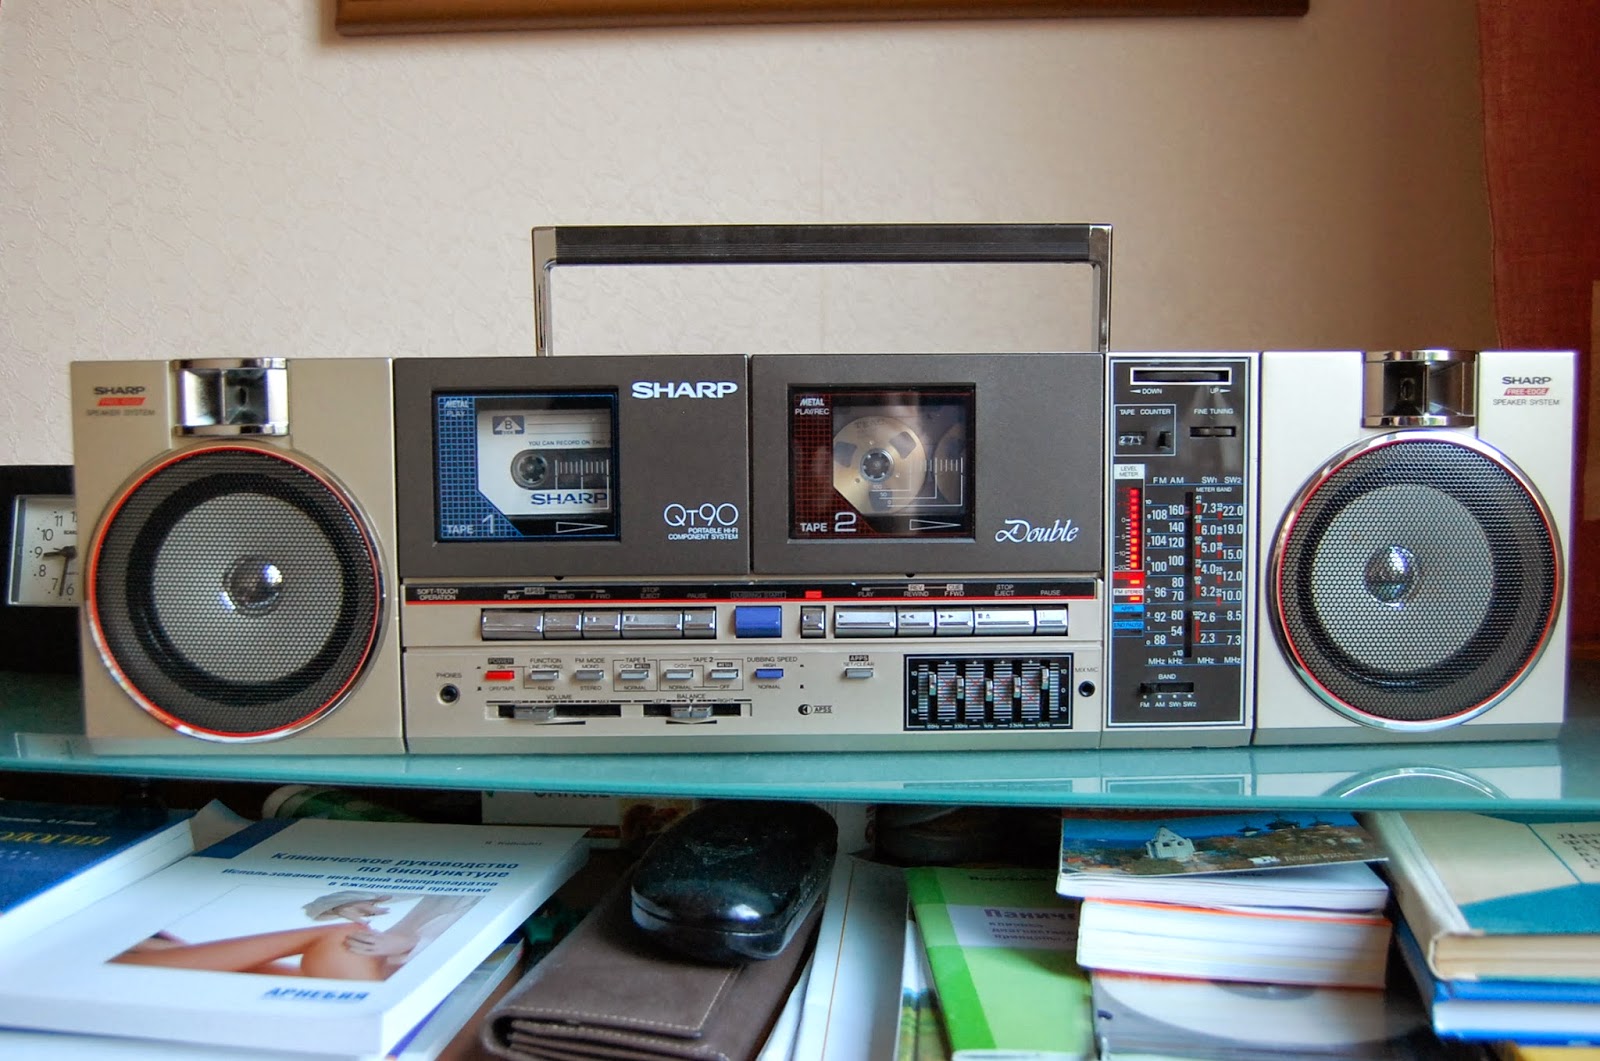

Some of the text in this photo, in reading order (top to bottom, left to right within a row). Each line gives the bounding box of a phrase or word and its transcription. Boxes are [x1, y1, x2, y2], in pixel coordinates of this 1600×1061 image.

[1502, 376, 1552, 384] SHARP
[94, 386, 145, 395] SHARP
[632, 381, 738, 399] SHARP
[799, 398, 824, 406] METAL
[505, 420, 512, 430] B
[531, 493, 608, 505] SHARP
[1168, 505, 1185, 515] 160
[1202, 503, 1216, 513] 7.3
[1222, 506, 1243, 516] 22.0
[1152, 510, 1167, 520] 108
[55, 515, 63, 527] 11
[447, 514, 494, 534] TAPE 1
[801, 512, 857, 532] TAPE 2
[995, 519, 1079, 543] Double
[1168, 522, 1185, 533] 140
[1201, 525, 1216, 535] 6.0
[1223, 524, 1243, 534] 19.0
[42, 529, 53, 541] 10
[1151, 536, 1167, 546] 104
[1168, 537, 1184, 548] 120
[34, 546, 43, 558] 9
[1201, 543, 1216, 553] 5.0
[1222, 549, 1242, 559] 15.0
[1168, 556, 1184, 566] 100
[39, 564, 46, 577] 8
[1151, 562, 1167, 572] 100
[1201, 564, 1216, 574] 4.0
[1222, 571, 1242, 581] 12.0
[52, 578, 58, 590] 7
[1172, 577, 1184, 588] 80
[66, 583, 74, 595] 6
[1154, 587, 1167, 598] 96
[1201, 586, 1215, 596] 3.2
[1172, 591, 1184, 601] 70
[1222, 590, 1241, 601] 10.0
[1154, 612, 1167, 622] 92
[1171, 610, 1184, 620] 60
[1200, 612, 1216, 622] 2.6
[1226, 610, 1241, 621] 8.5
[1171, 626, 1183, 636] 54
[1154, 635, 1166, 645] 88
[1200, 633, 1215, 643] 2.3
[1226, 635, 1241, 645] 7.3
[271, 852, 519, 869] Клиническое руководство
[222, 868, 499, 887] Использование инъекций биопрепаратов
[386, 867, 509, 879] биопунктуре
[340, 882, 424, 891] ежедневной
[428, 885, 492, 893] практике
[265, 987, 370, 1000] АРНЕБИЯ
